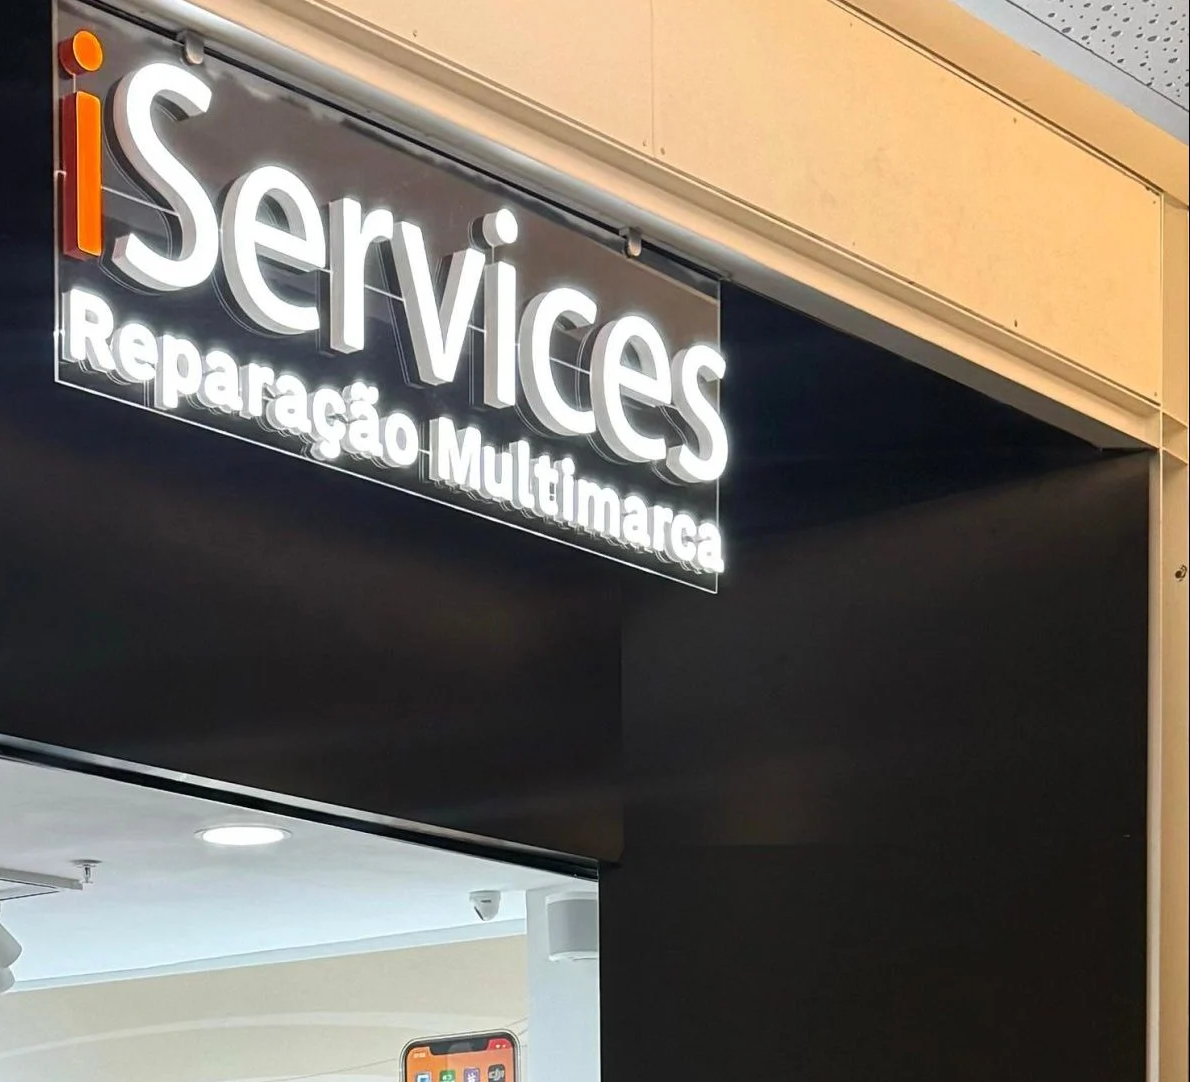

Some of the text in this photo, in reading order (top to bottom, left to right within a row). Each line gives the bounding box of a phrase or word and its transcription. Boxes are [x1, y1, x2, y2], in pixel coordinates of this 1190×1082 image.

[60, 29, 729, 483] iServices
[66, 288, 724, 573] Reparação Multimarca
